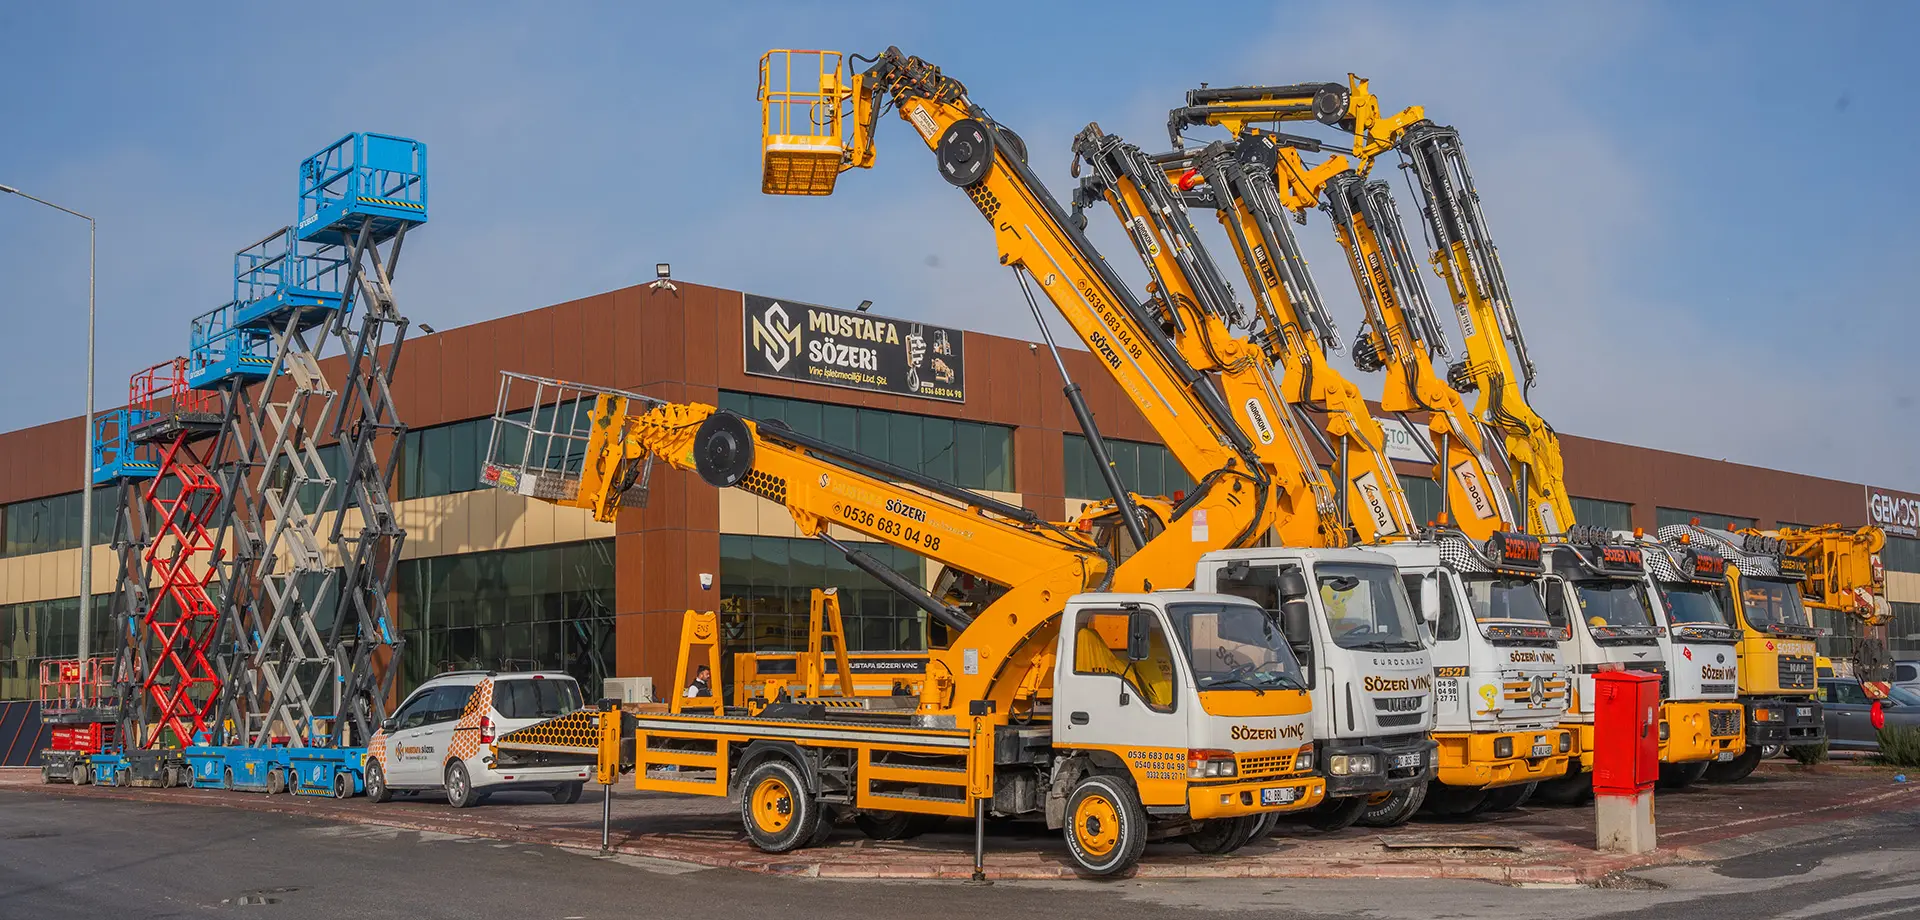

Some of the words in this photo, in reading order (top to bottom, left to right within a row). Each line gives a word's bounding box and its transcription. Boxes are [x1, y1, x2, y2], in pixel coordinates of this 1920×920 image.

[1443, 179, 1459, 217] MUSTAFA
[808, 309, 900, 345] MUSTAFA
[1084, 287, 1106, 313] 0536
[1103, 311, 1119, 333] 683
[1118, 330, 1131, 347] 04
[1128, 342, 1143, 360] 98
[808, 366, 823, 377] Vinç
[862, 374, 876, 384] Ltd.
[935, 387, 945, 396] 683
[954, 390, 962, 398] 98
[843, 505, 875, 527] 0536
[877, 517, 901, 537] 683
[904, 527, 921, 544] 04
[923, 534, 941, 551] 98
[1373, 658, 1424, 666] EUROCARGO
[1540, 651, 1556, 665] VİNÇ
[1438, 667, 1466, 677] 2521
[1411, 673, 1432, 692] VİNÇ
[1387, 697, 1418, 712] IVECO
[1279, 722, 1304, 740] VİNÇ
[1128, 750, 1146, 759] 0536
[1148, 751, 1162, 760] 683
[1164, 752, 1174, 760] 04
[1176, 753, 1185, 761] 98
[1135, 761, 1151, 769] 0540
[1152, 761, 1165, 770] 683
[1167, 762, 1175, 770] 04
